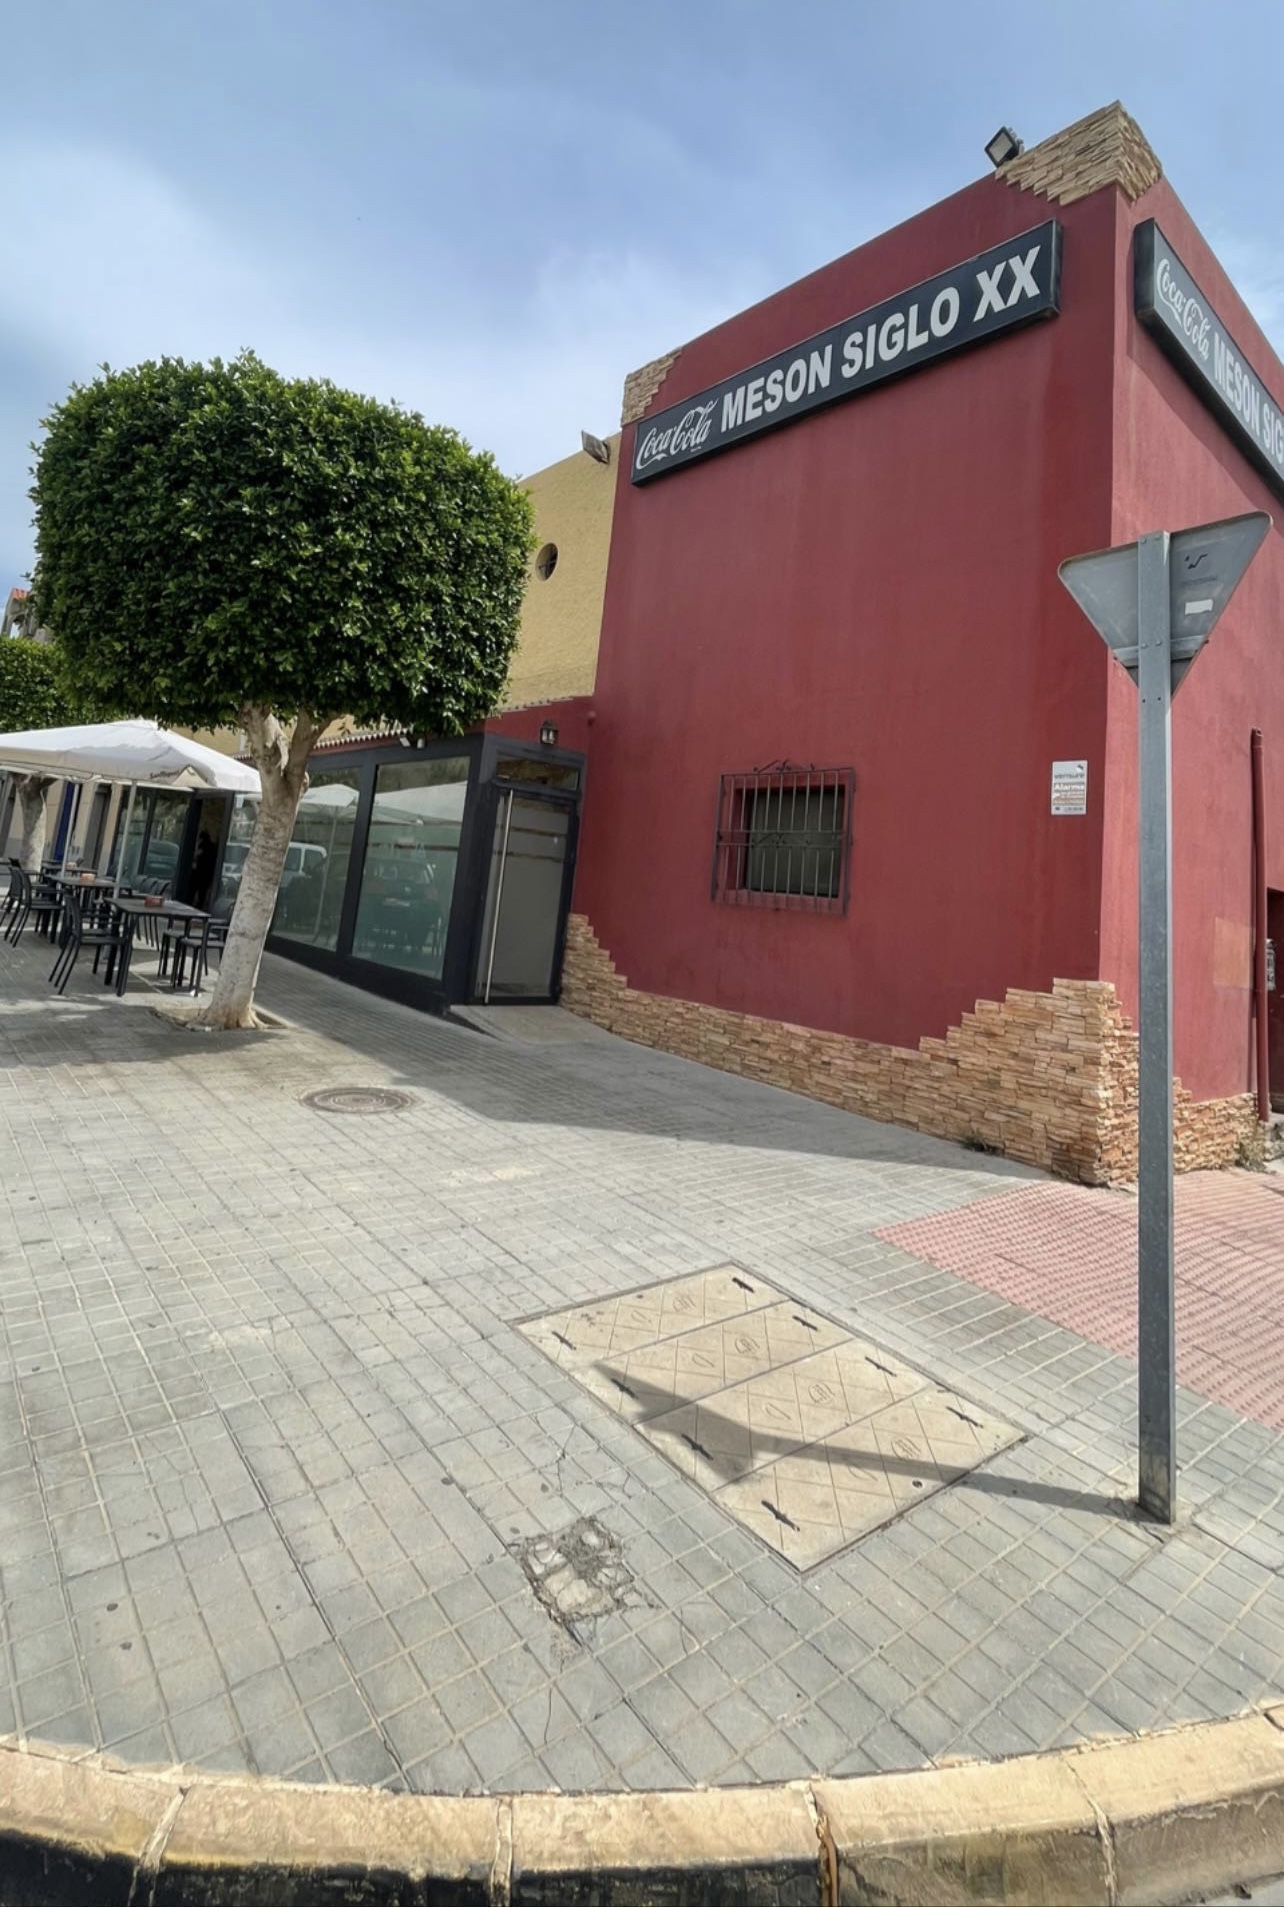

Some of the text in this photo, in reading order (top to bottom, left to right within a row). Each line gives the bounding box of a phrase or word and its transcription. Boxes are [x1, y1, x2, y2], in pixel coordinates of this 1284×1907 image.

[720, 344, 833, 433] MESON
[841, 286, 960, 379] SIGLO
[973, 244, 1042, 322] XX
[1214, 331, 1260, 437] MESON
